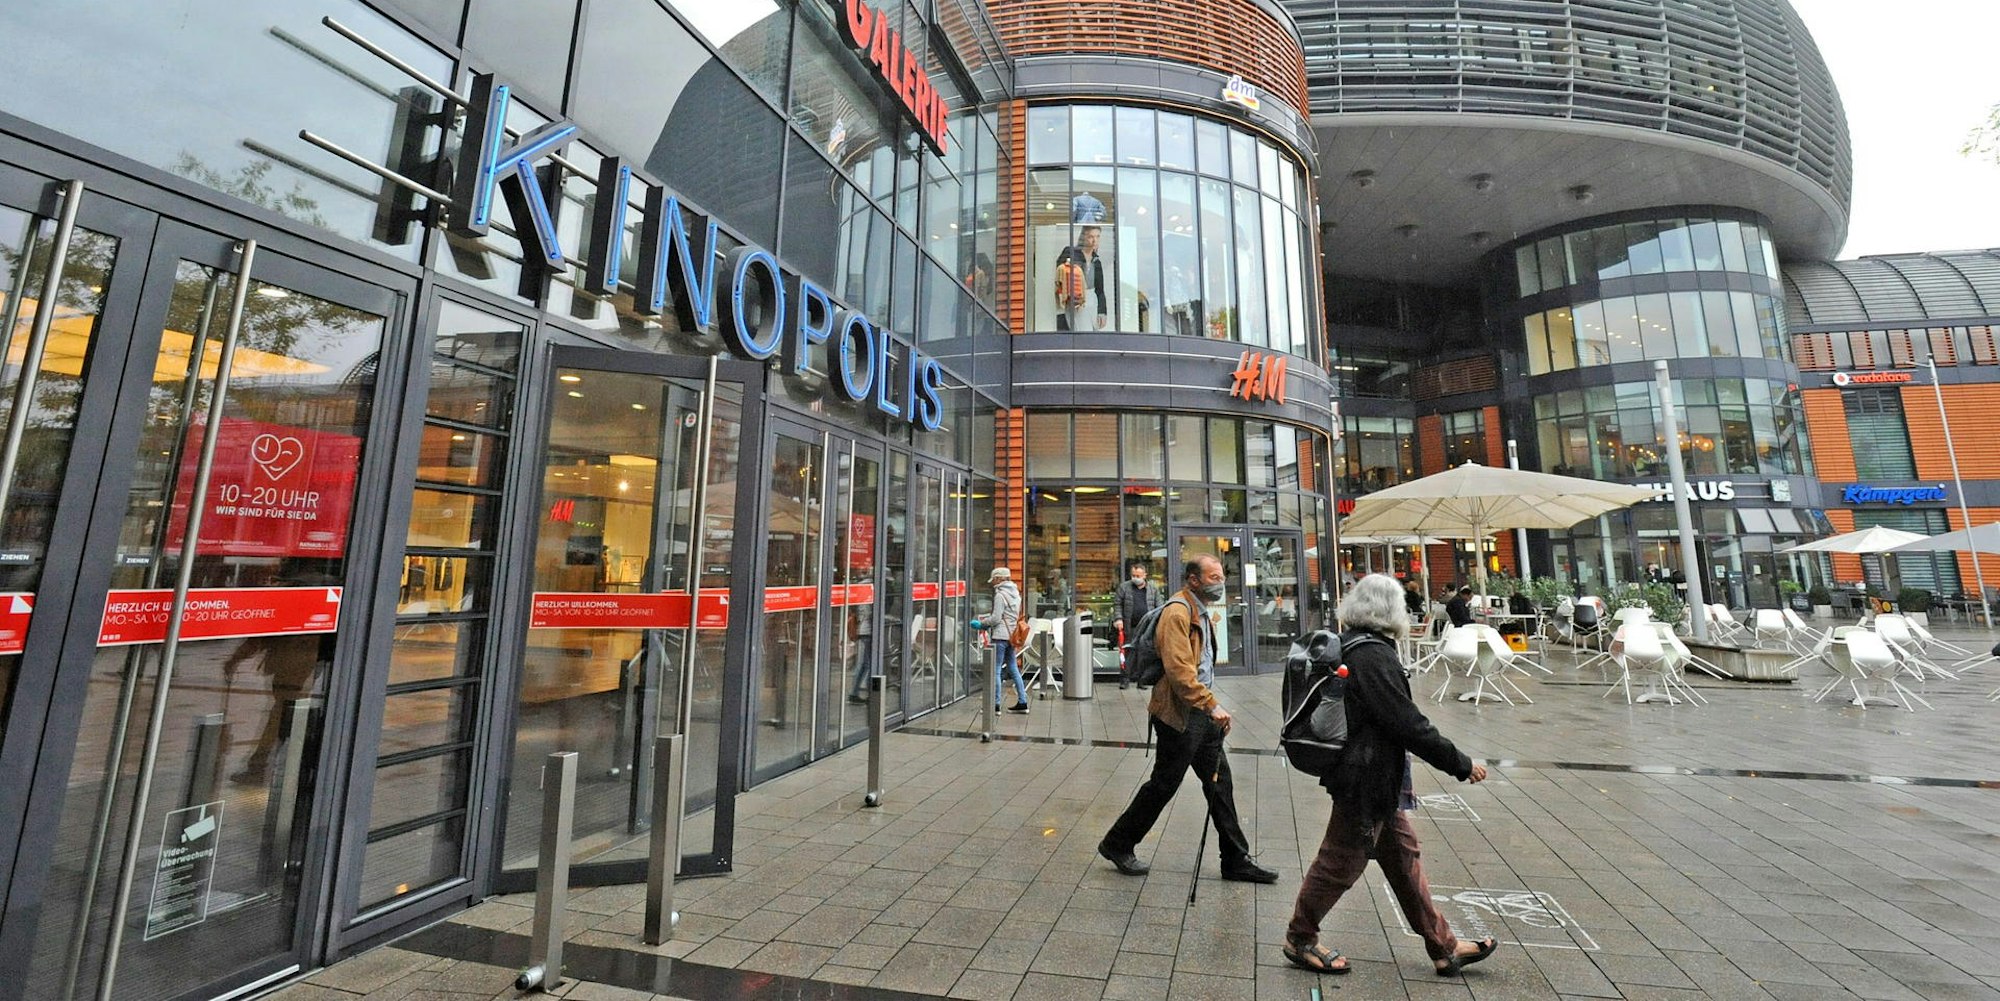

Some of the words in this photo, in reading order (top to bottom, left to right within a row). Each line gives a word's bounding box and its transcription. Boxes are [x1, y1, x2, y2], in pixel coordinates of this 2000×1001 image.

[846, 0, 949, 155] GALERIE
[1230, 77, 1254, 98] dm
[466, 78, 944, 433] KINOPOLIS
[1231, 350, 1287, 405] H&M
[1852, 372, 1912, 383] vodafone
[281, 489, 320, 509] UHR
[215, 505, 236, 516] WIR
[238, 507, 263, 517] SIND
[265, 507, 285, 519] FÜR
[287, 510, 302, 519] SIE
[303, 511, 317, 520] DA
[108, 602, 160, 613] HERZLICH
[536, 600, 570, 608] HERZLICH
[152, 612, 169, 623] VO
[211, 610, 229, 620] UHR
[231, 608, 276, 620] GEÖFFNET.
[163, 846, 189, 858] Video-
